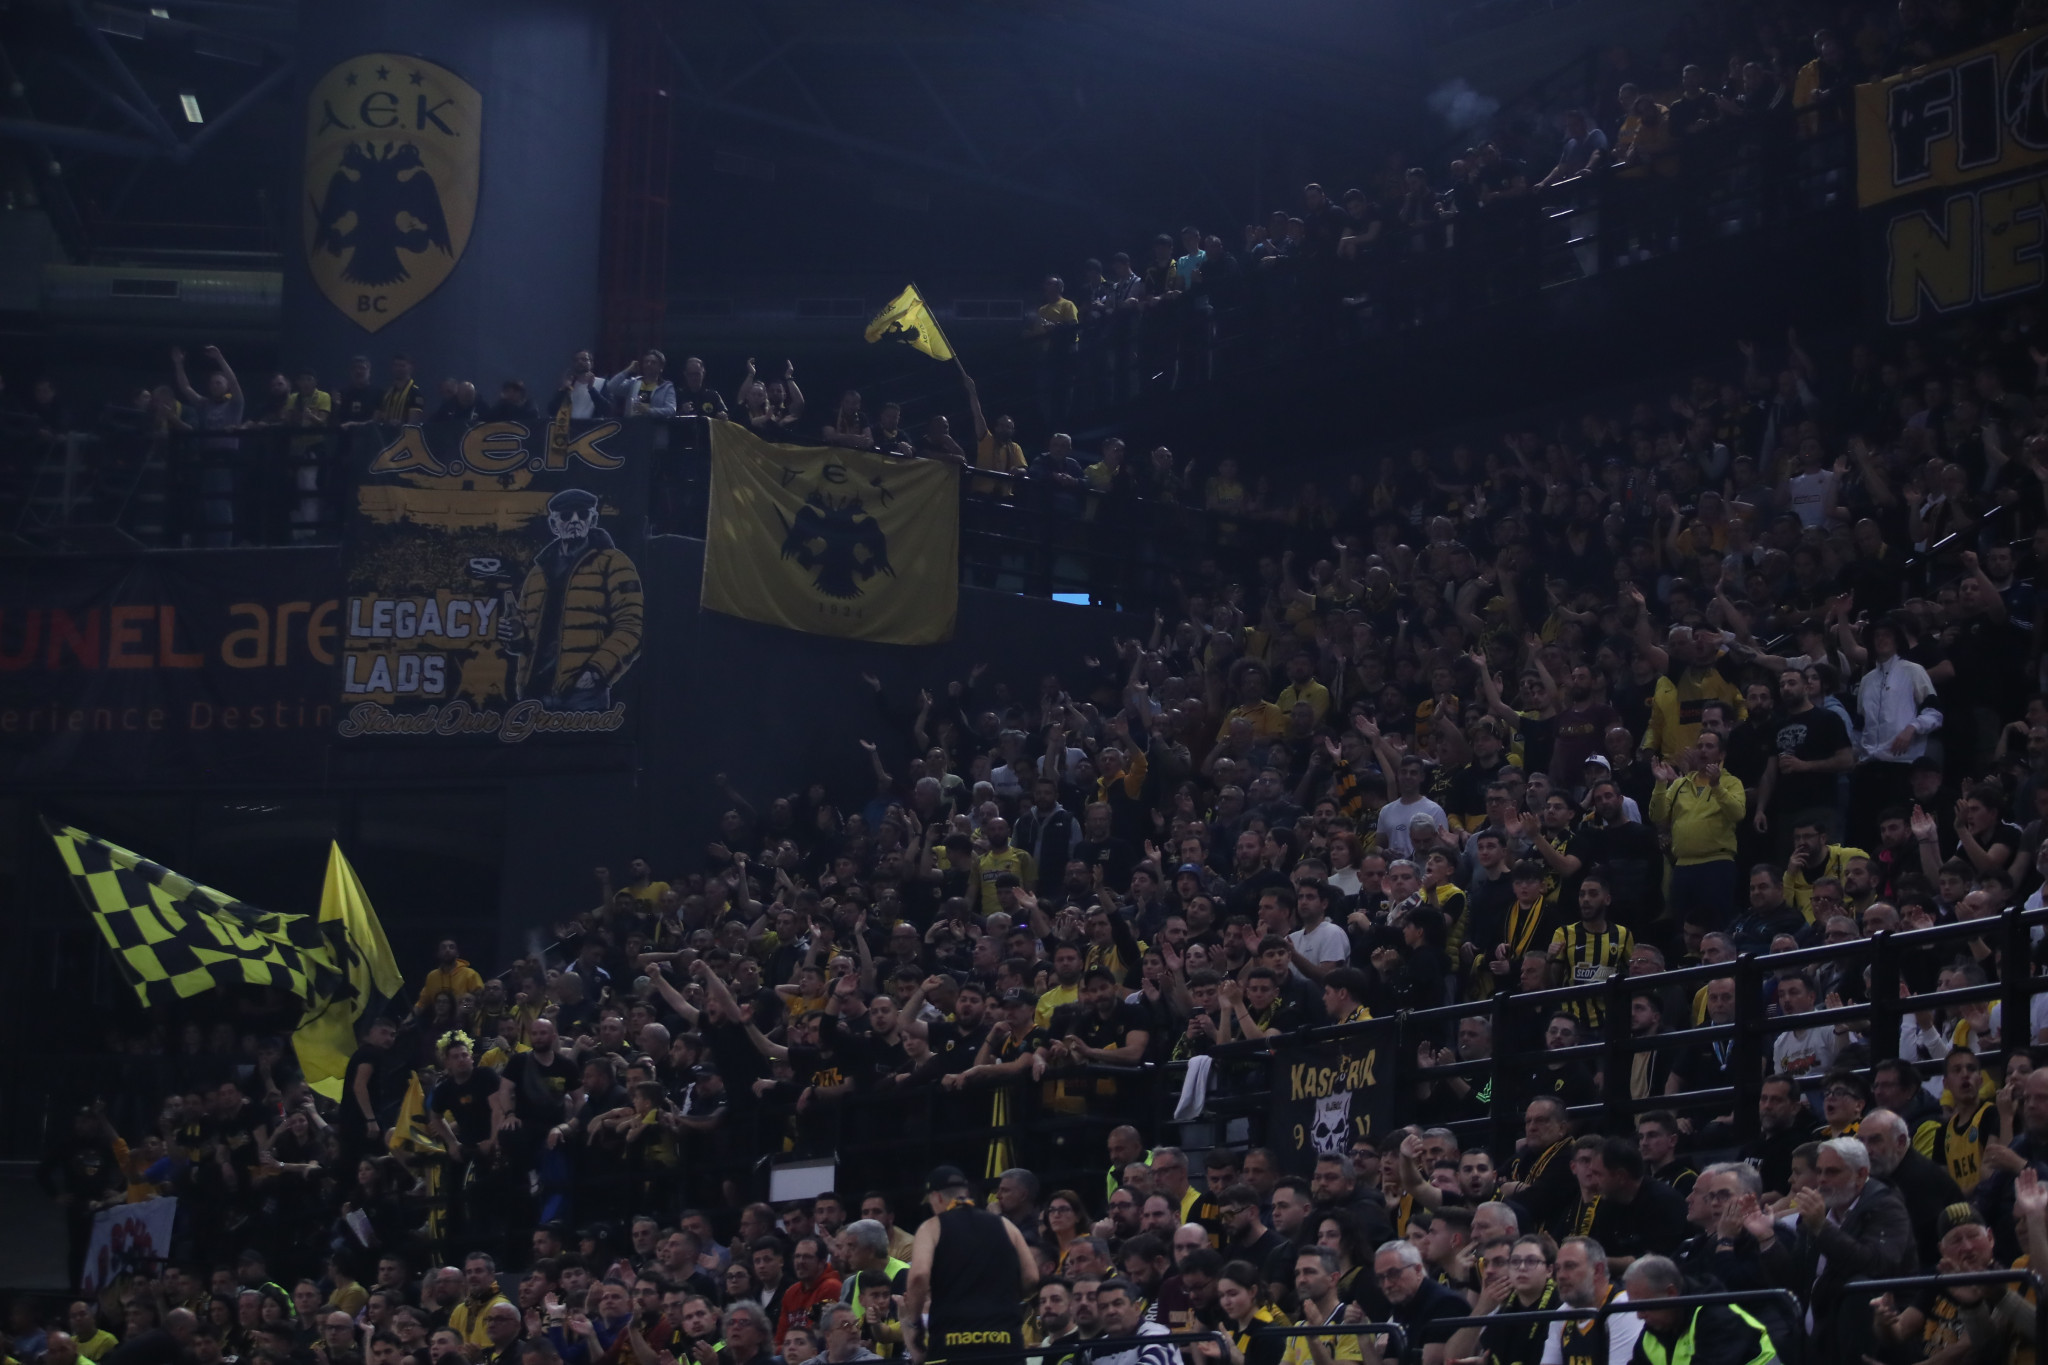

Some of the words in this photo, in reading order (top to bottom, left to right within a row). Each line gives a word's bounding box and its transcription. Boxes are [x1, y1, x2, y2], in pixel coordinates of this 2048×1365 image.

[357, 294, 388, 313] BC
[350, 597, 499, 639] LEGACY
[344, 654, 446, 694] LADS
[338, 701, 439, 738] Stand
[434, 699, 503, 735] Our
[498, 699, 626, 743] Ground
[1953, 1153, 1977, 1179] AEK
[945, 1330, 1012, 1346] macron
